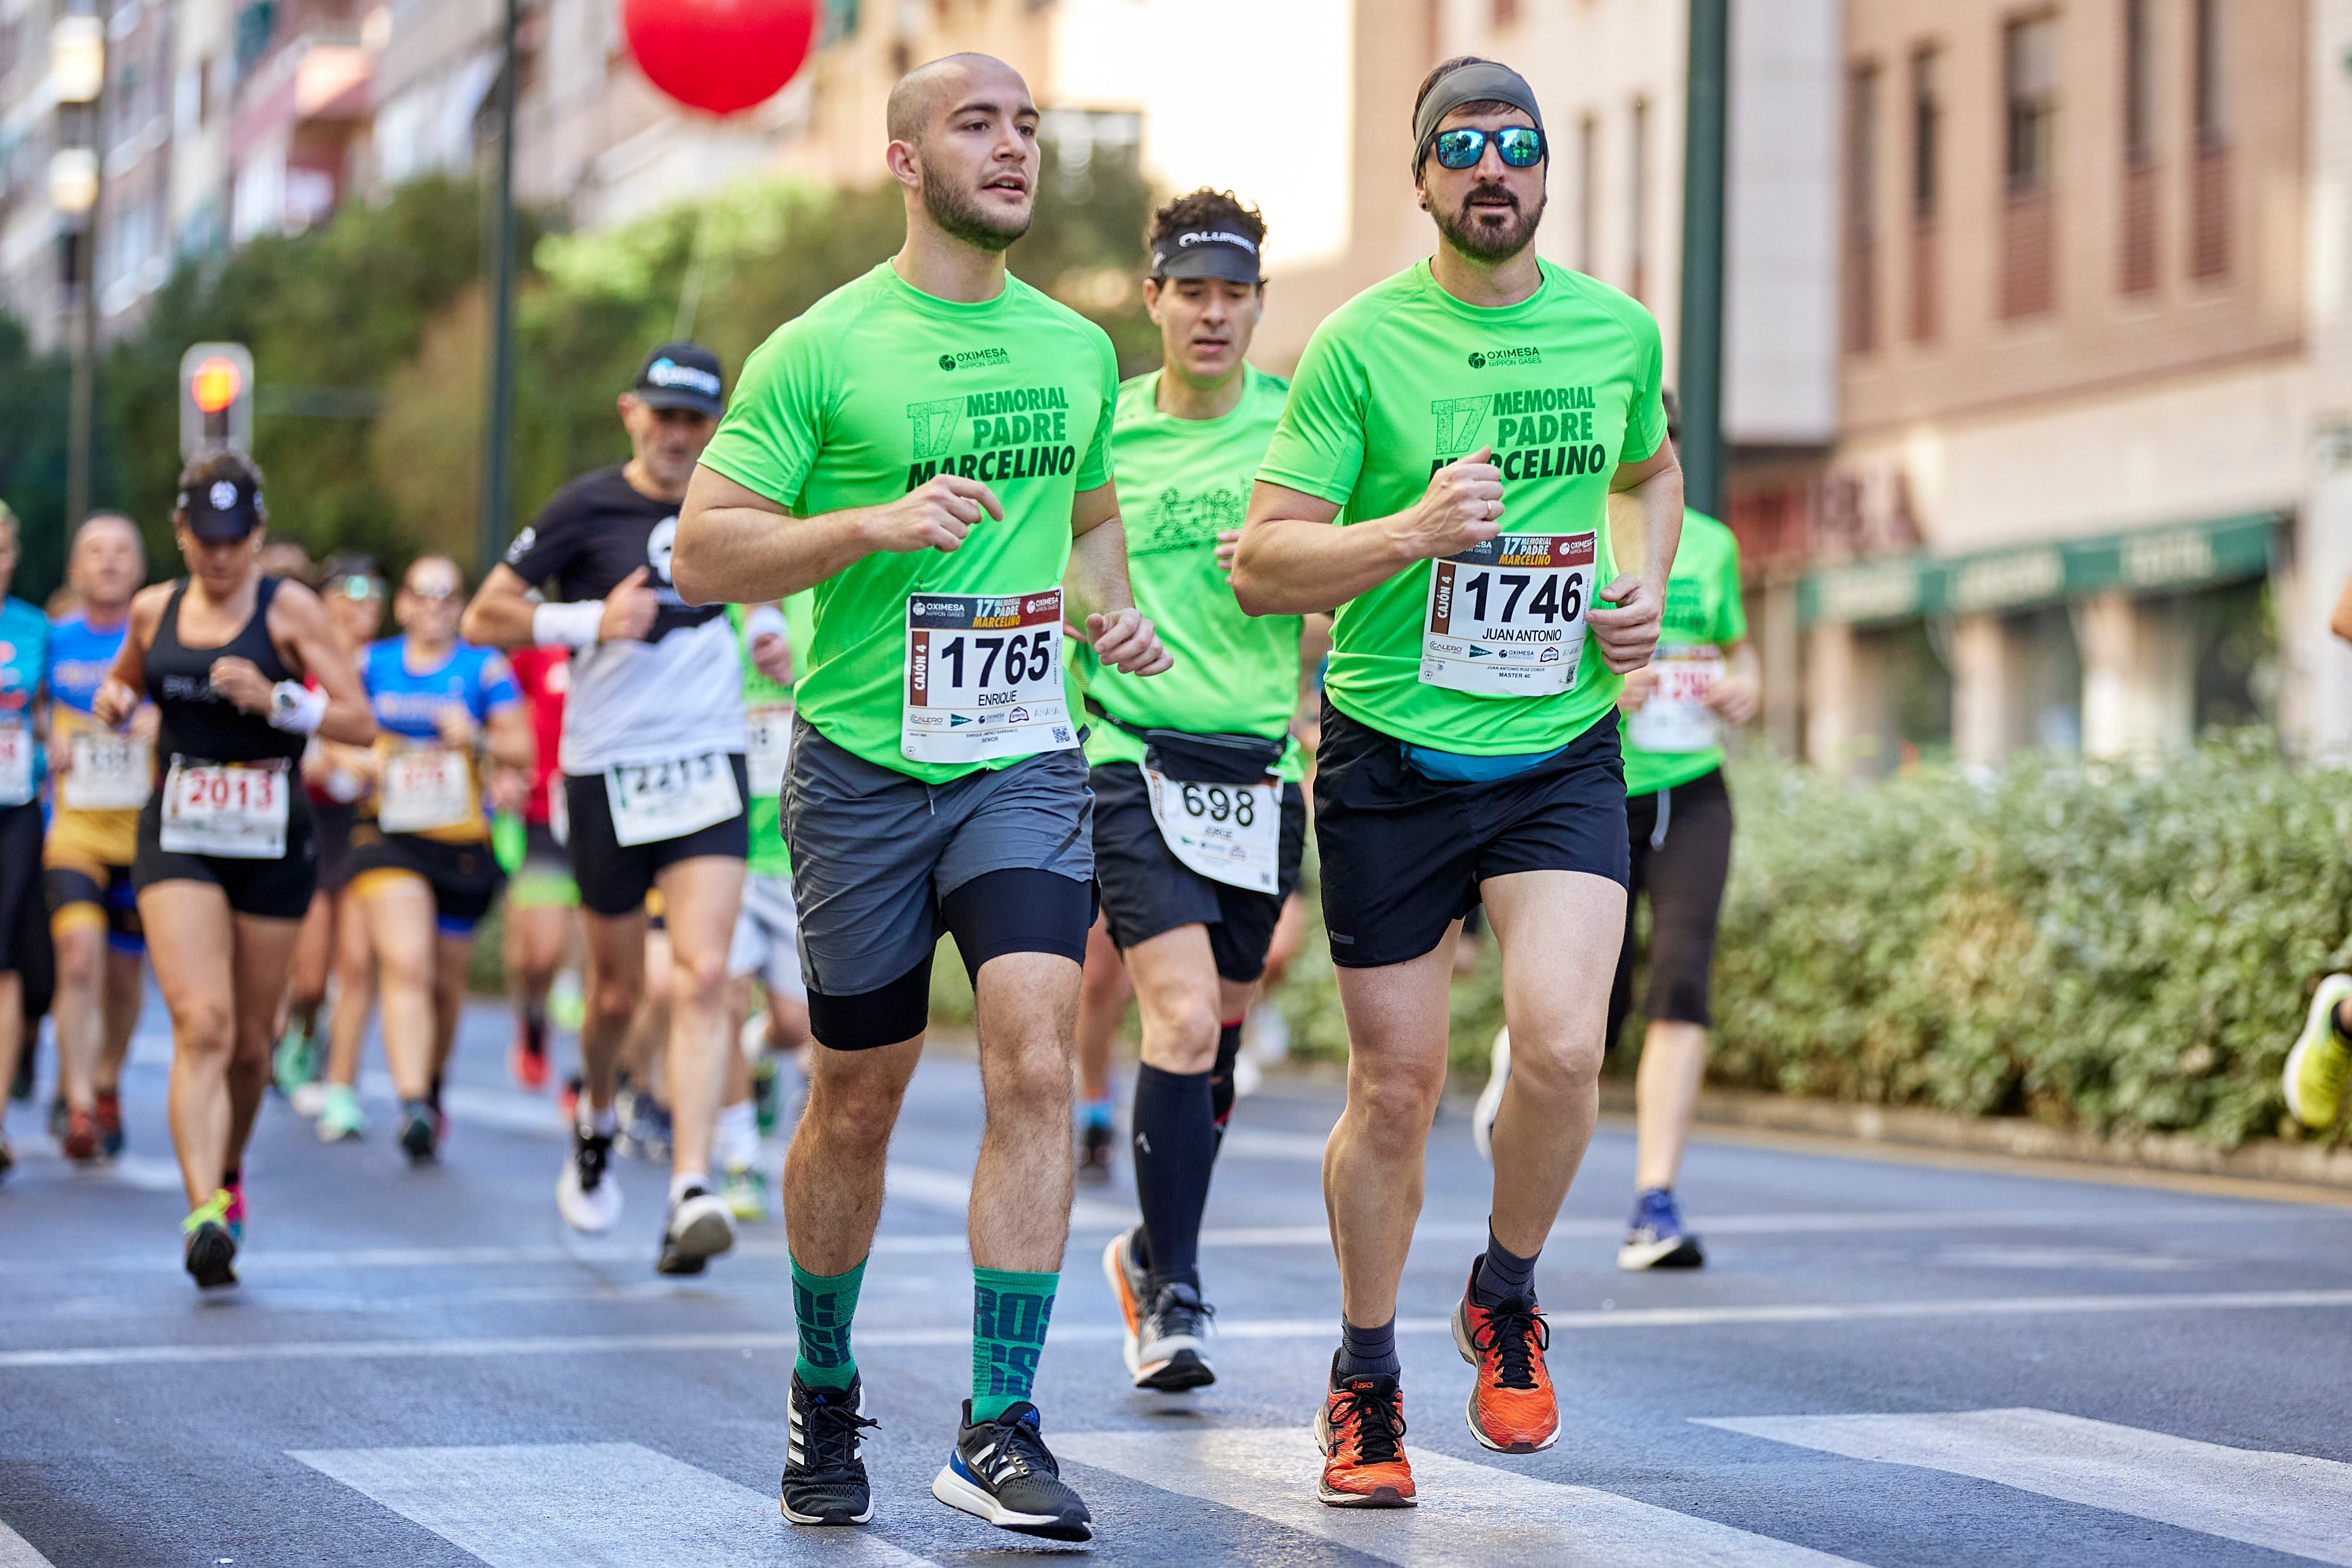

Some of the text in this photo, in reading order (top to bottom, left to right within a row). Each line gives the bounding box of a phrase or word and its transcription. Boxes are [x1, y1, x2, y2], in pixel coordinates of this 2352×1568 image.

[957, 347, 1008, 361] OXIMESA
[1487, 347, 1540, 360] OXIMESA
[1489, 356, 1542, 367] NIPPON GASES
[958, 357, 1010, 370] NIPPON GASES
[967, 387, 1069, 417] MEMORIAL
[1492, 386, 1596, 416] MEMORIAL
[907, 397, 964, 459] 17
[973, 412, 1065, 449] PADRE
[1432, 394, 1492, 455] 17
[1497, 412, 1593, 448] PADRE
[1502, 537, 1522, 556] 17
[1520, 545, 1549, 555] PADRE
[1498, 554, 1551, 566] MARCELINO
[994, 598, 1021, 607] MEMORIAL
[1035, 597, 1058, 607] OXIMESA
[1437, 587, 1450, 618] CAJÓN
[1465, 572, 1583, 624] 1746
[976, 599, 995, 617] 17
[994, 605, 1019, 617] PADRE
[972, 615, 1021, 627] MARCELINO
[1482, 628, 1562, 641] JUAN ANTONIO
[1431, 643, 1463, 652] CALERO
[914, 644, 927, 690] CAJÓN 4
[941, 630, 1051, 688] 1765
[978, 690, 1017, 706] ENRIQUE
[191, 768, 272, 811] 2013
[1182, 785, 1254, 827] 698
